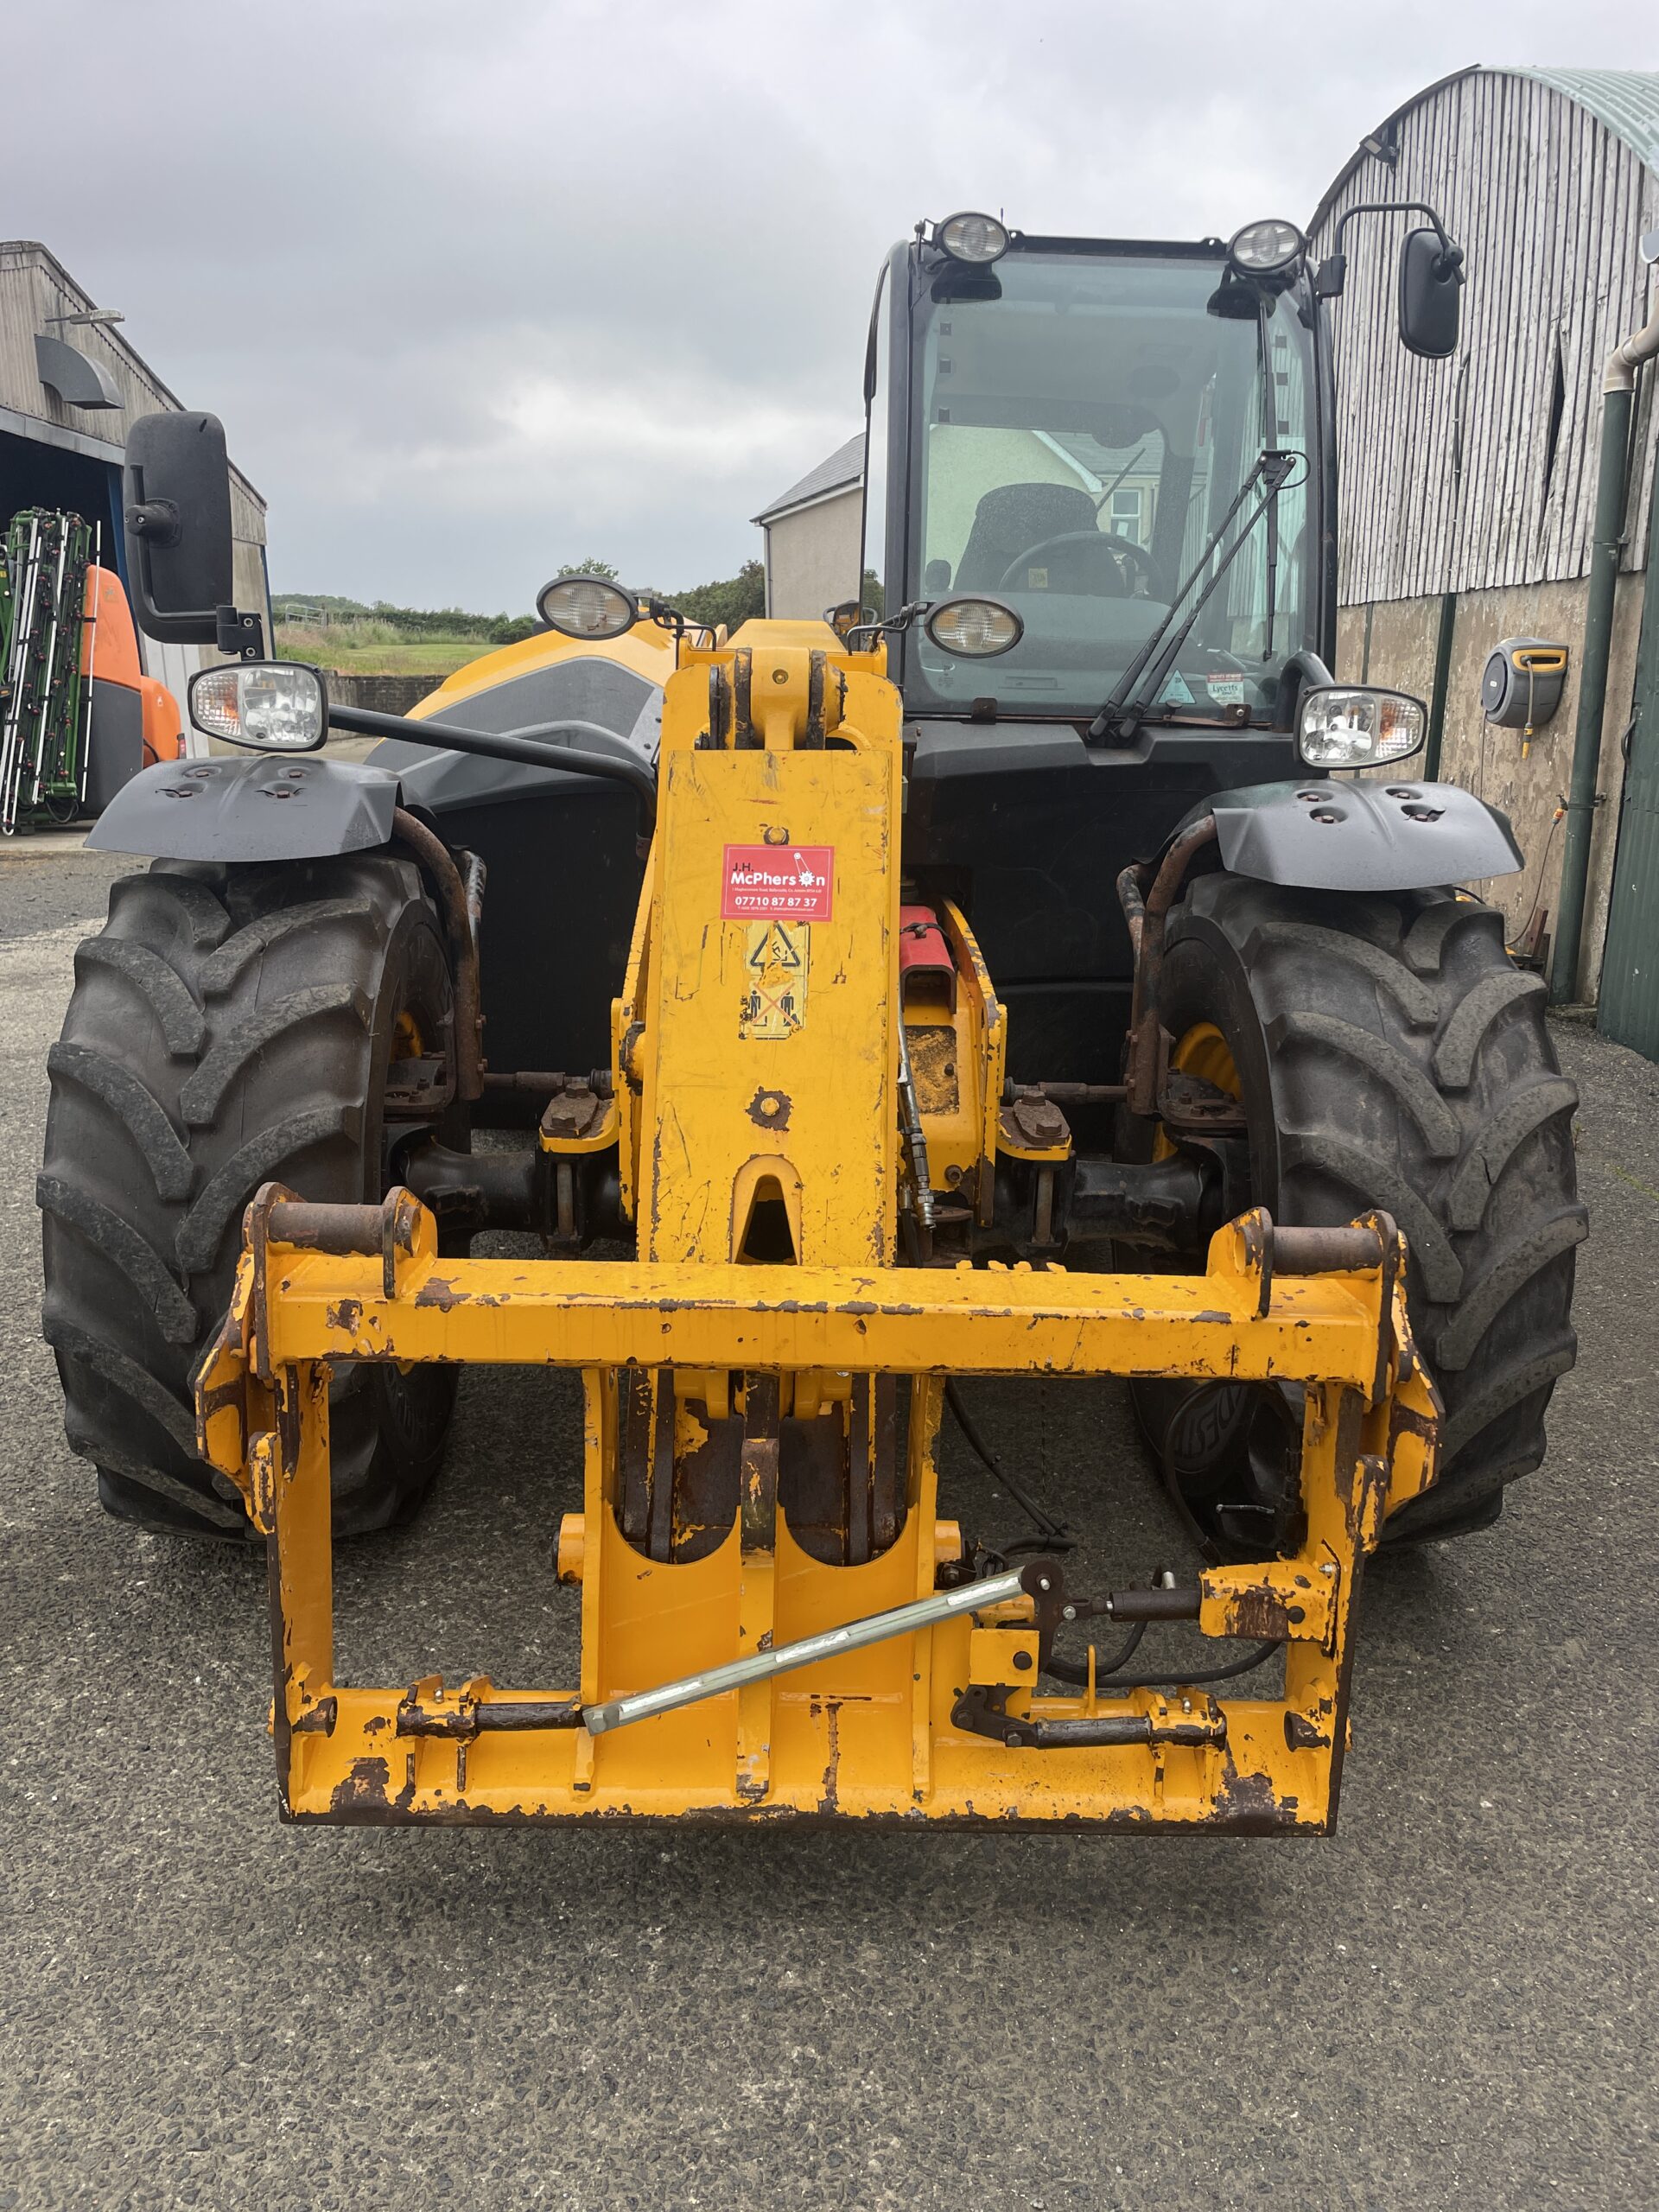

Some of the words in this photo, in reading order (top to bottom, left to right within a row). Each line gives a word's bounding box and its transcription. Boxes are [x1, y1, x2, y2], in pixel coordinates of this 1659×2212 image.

[732, 862, 754, 872] J.H.
[734, 896, 769, 906] 07710
[771, 897, 785, 906] 87
[787, 897, 802, 906] 87
[804, 898, 817, 907] 37
